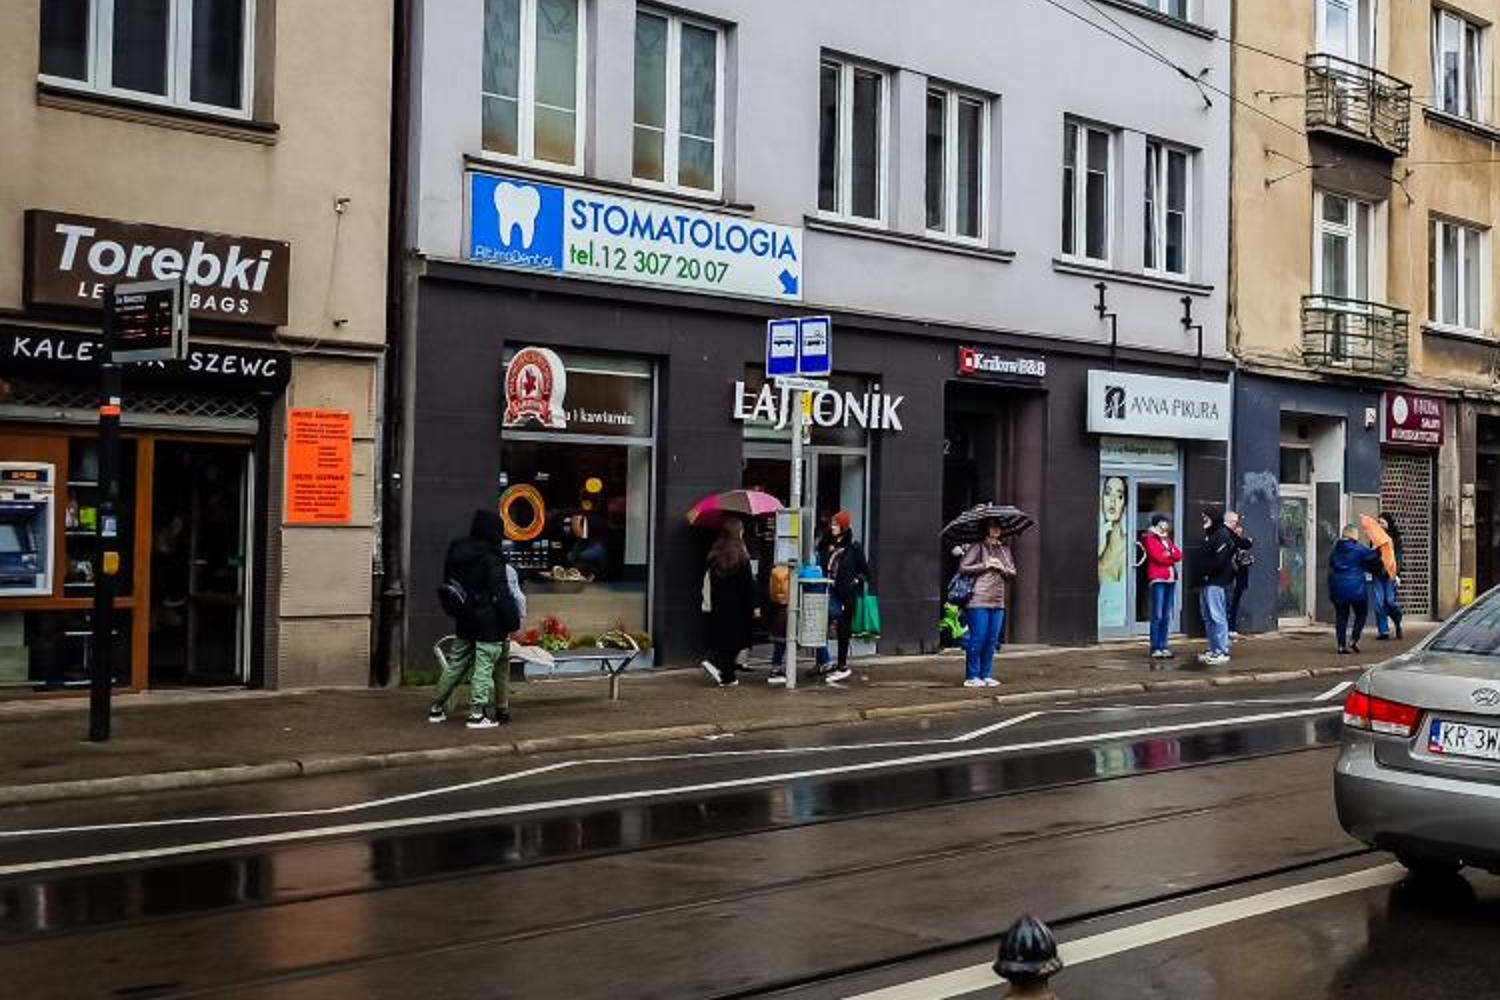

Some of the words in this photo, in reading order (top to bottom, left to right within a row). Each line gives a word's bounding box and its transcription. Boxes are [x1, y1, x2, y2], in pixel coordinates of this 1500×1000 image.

[570, 199, 797, 262] STOMATOLOGIA
[55, 223, 272, 293] Torebki
[633, 249, 671, 276] 307
[189, 293, 250, 314] BAGS
[188, 351, 278, 378] SZEWC
[1130, 396, 1169, 416] ANNA
[1171, 398, 1220, 420] PIKURA
[1442, 723, 1469, 748] KR
